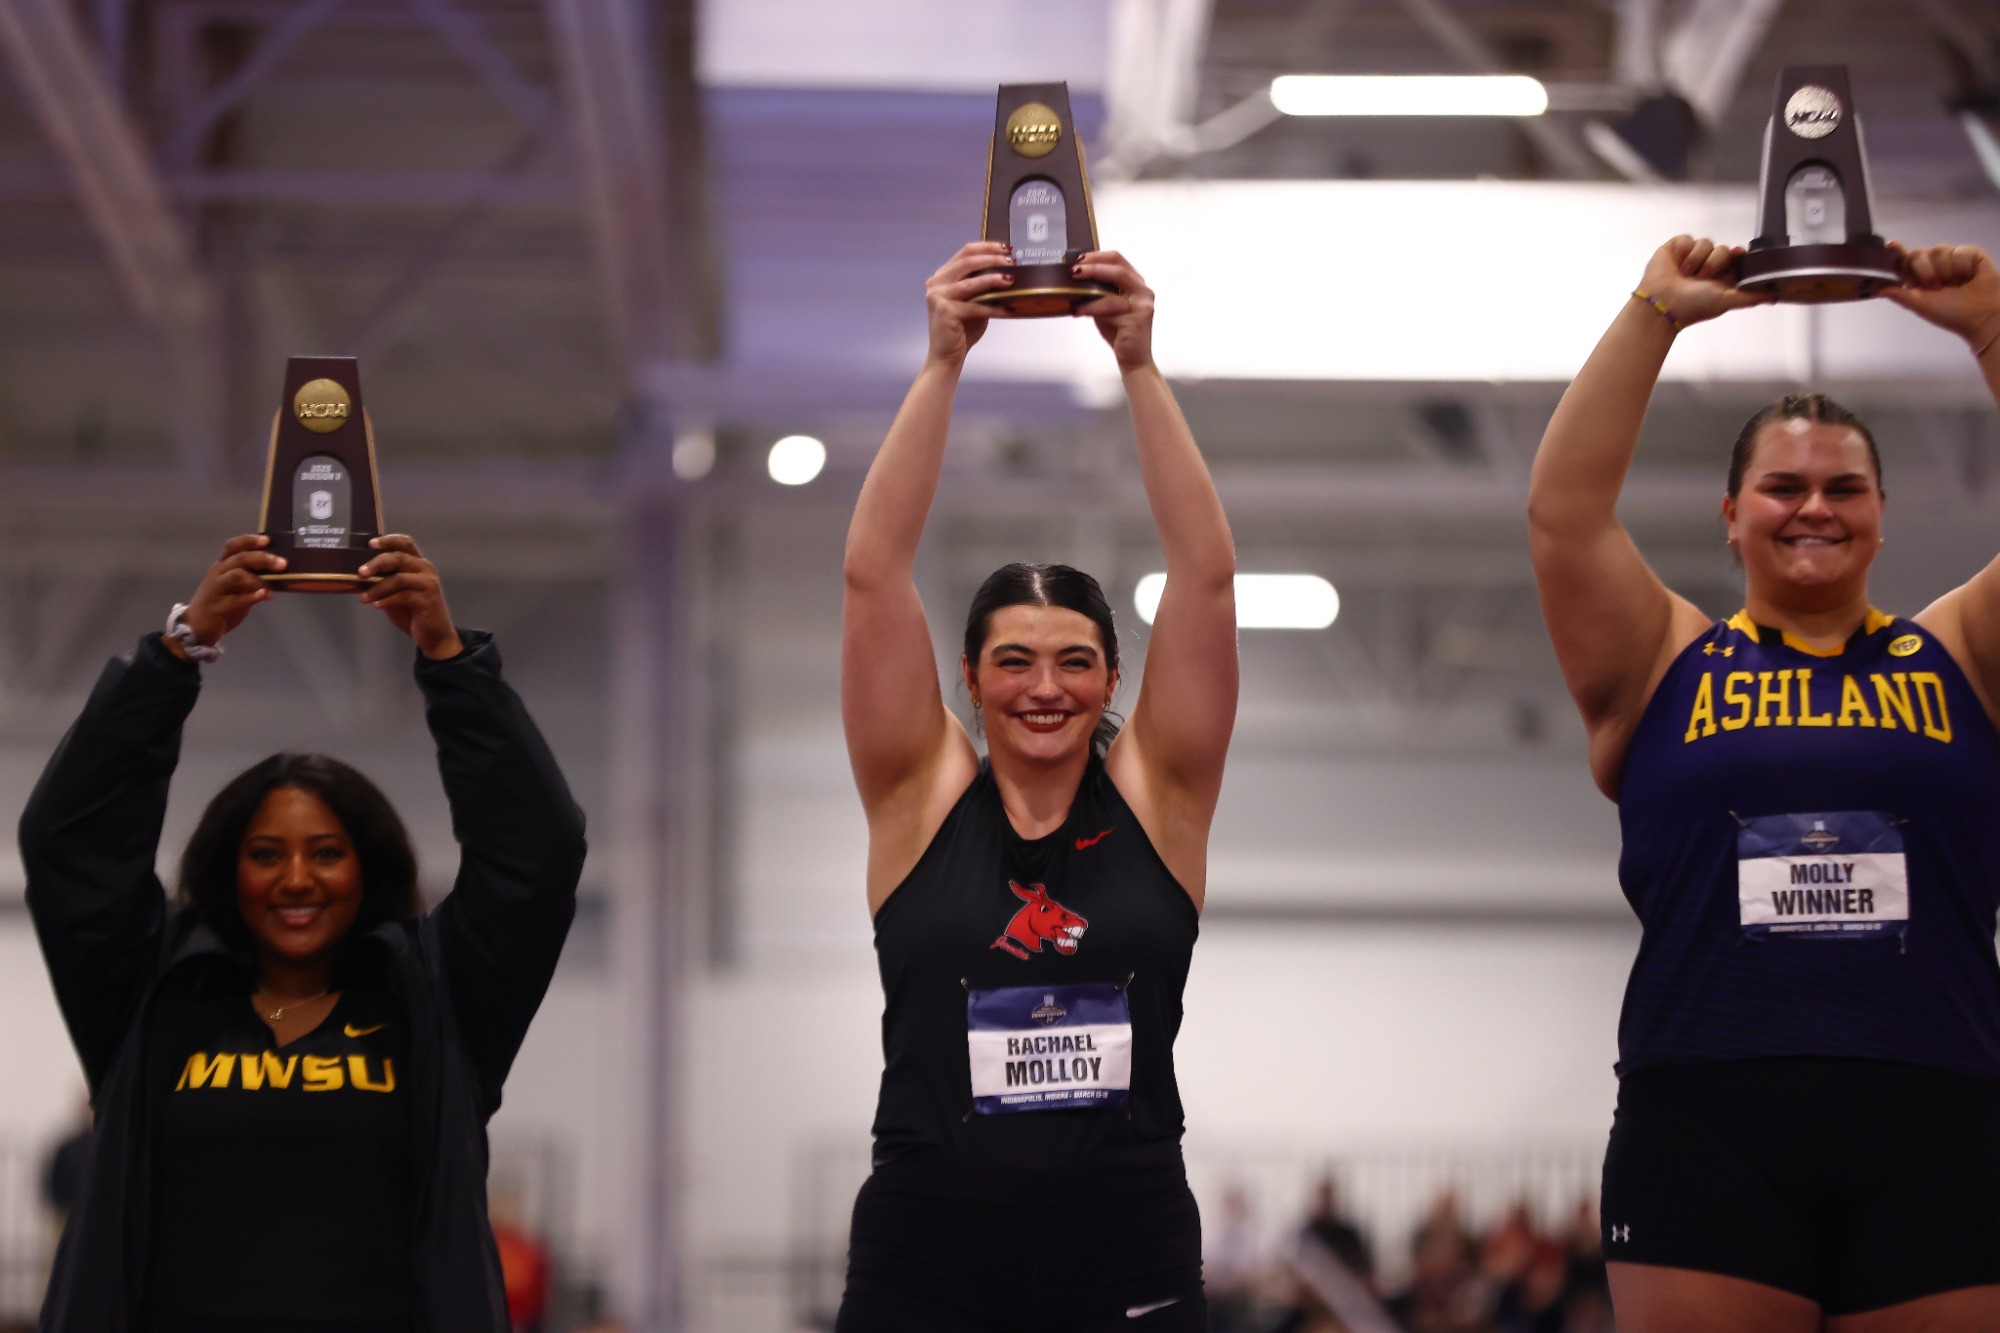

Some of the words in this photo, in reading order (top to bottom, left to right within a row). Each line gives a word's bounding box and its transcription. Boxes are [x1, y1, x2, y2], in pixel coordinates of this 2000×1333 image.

[1011, 124, 1058, 143] NCAA
[300, 403, 347, 417] NCAA
[1892, 638, 1917, 653] YEP
[1684, 668, 1953, 744] ASHLAND
[1790, 863, 1854, 884] MOLLY
[1771, 889, 1874, 915] WINNER
[1007, 1033, 1097, 1056] RACHAEL
[174, 1050, 396, 1093] MWSU
[1005, 1057, 1102, 1088] MOLLOY
